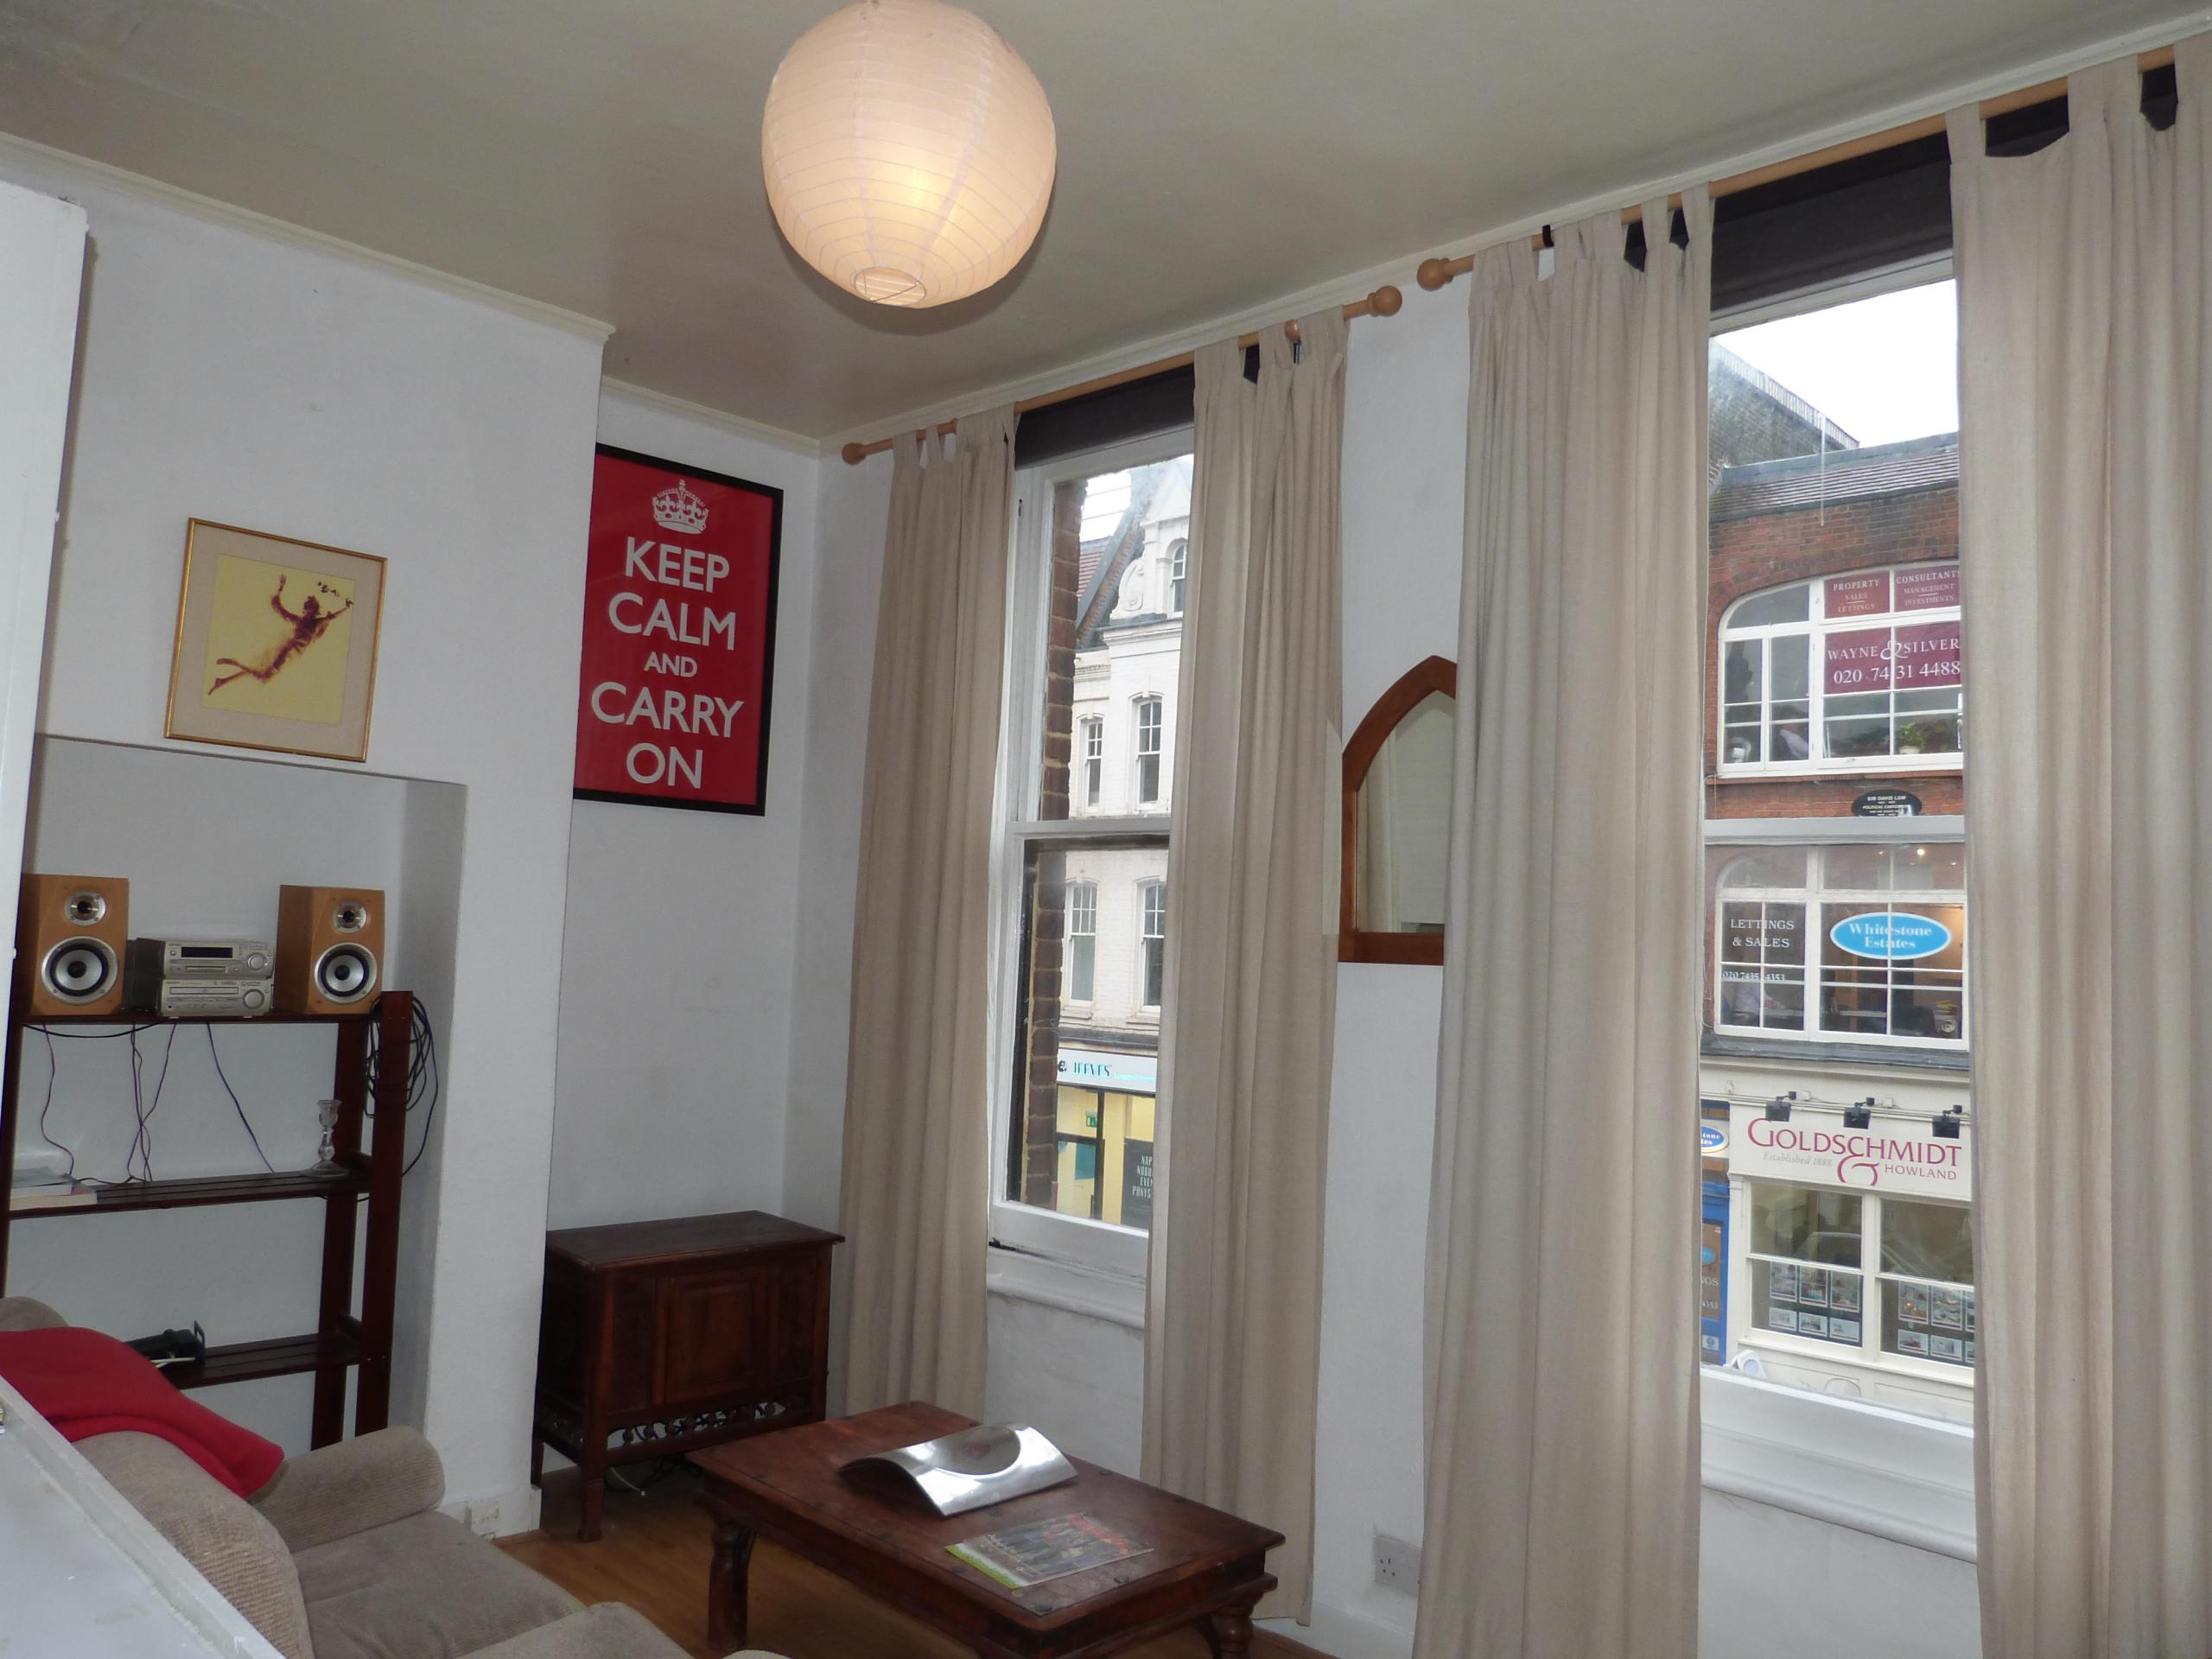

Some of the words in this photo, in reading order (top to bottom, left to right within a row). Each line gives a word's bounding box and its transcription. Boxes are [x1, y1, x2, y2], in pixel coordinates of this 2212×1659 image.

[625, 536, 730, 594] KEEP
[1833, 579, 1880, 591] PROPERTY
[1904, 583, 1955, 594] MANAGEMENT
[1904, 594, 1955, 605] INVESTMENTS
[1838, 603, 1876, 613] LETTINGS
[608, 592, 736, 651] CALM
[1827, 646, 1878, 660] WAYNE
[1903, 639, 1961, 654] SILVER
[644, 652, 698, 678] AND
[1834, 669, 1862, 683] 020
[1918, 660, 1961, 677] 4488
[591, 681, 745, 738] CARRY
[626, 742, 703, 790] ON
[1731, 918, 1795, 931] LETTINGS
[1849, 923, 1932, 937] Whitestone
[1732, 937, 1742, 947] &
[1745, 937, 1790, 948] SALES
[1865, 936, 1916, 949] Estates
[1747, 1117, 1962, 1166] GOLDSCHMIDT
[1763, 1151, 1812, 1165] Established
[1813, 1156, 1833, 1167] 1888
[1885, 1164, 1957, 1180] HOWLAND
[1132, 1185, 1152, 1198] PONYS
